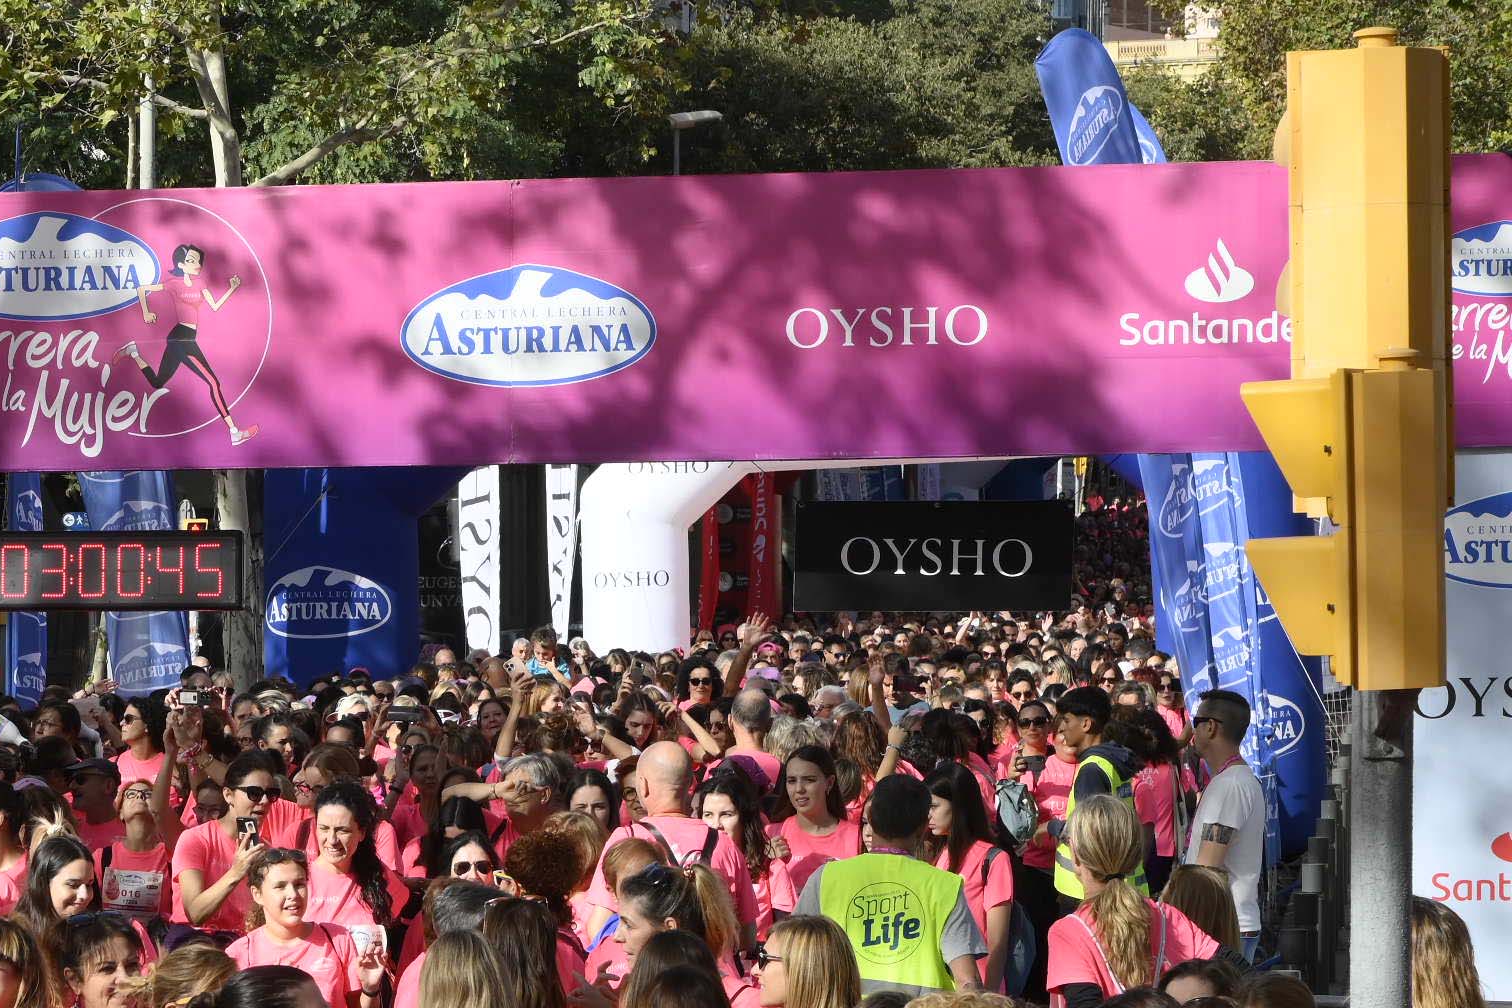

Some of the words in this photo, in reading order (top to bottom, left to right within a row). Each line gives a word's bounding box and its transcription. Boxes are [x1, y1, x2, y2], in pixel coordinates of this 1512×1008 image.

[63, 247, 135, 260] LECHERA
[459, 307, 538, 320] CENTRAL
[548, 305, 628, 318] LECHERA
[786, 305, 988, 348] OYSHO
[1119, 311, 1294, 346] Santande
[420, 312, 636, 356] ASTURIANA
[1470, 333, 1488, 360] la
[2, 374, 26, 412] la
[21, 364, 170, 457] Mujer
[0, 543, 223, 598] 03:00:45
[840, 536, 1033, 578] OYSHO
[594, 569, 670, 589] OYSHO
[269, 597, 382, 623] ASTURIANA
[121, 890, 141, 898] 016
[852, 891, 910, 920] Sport
[861, 912, 921, 950] Life
